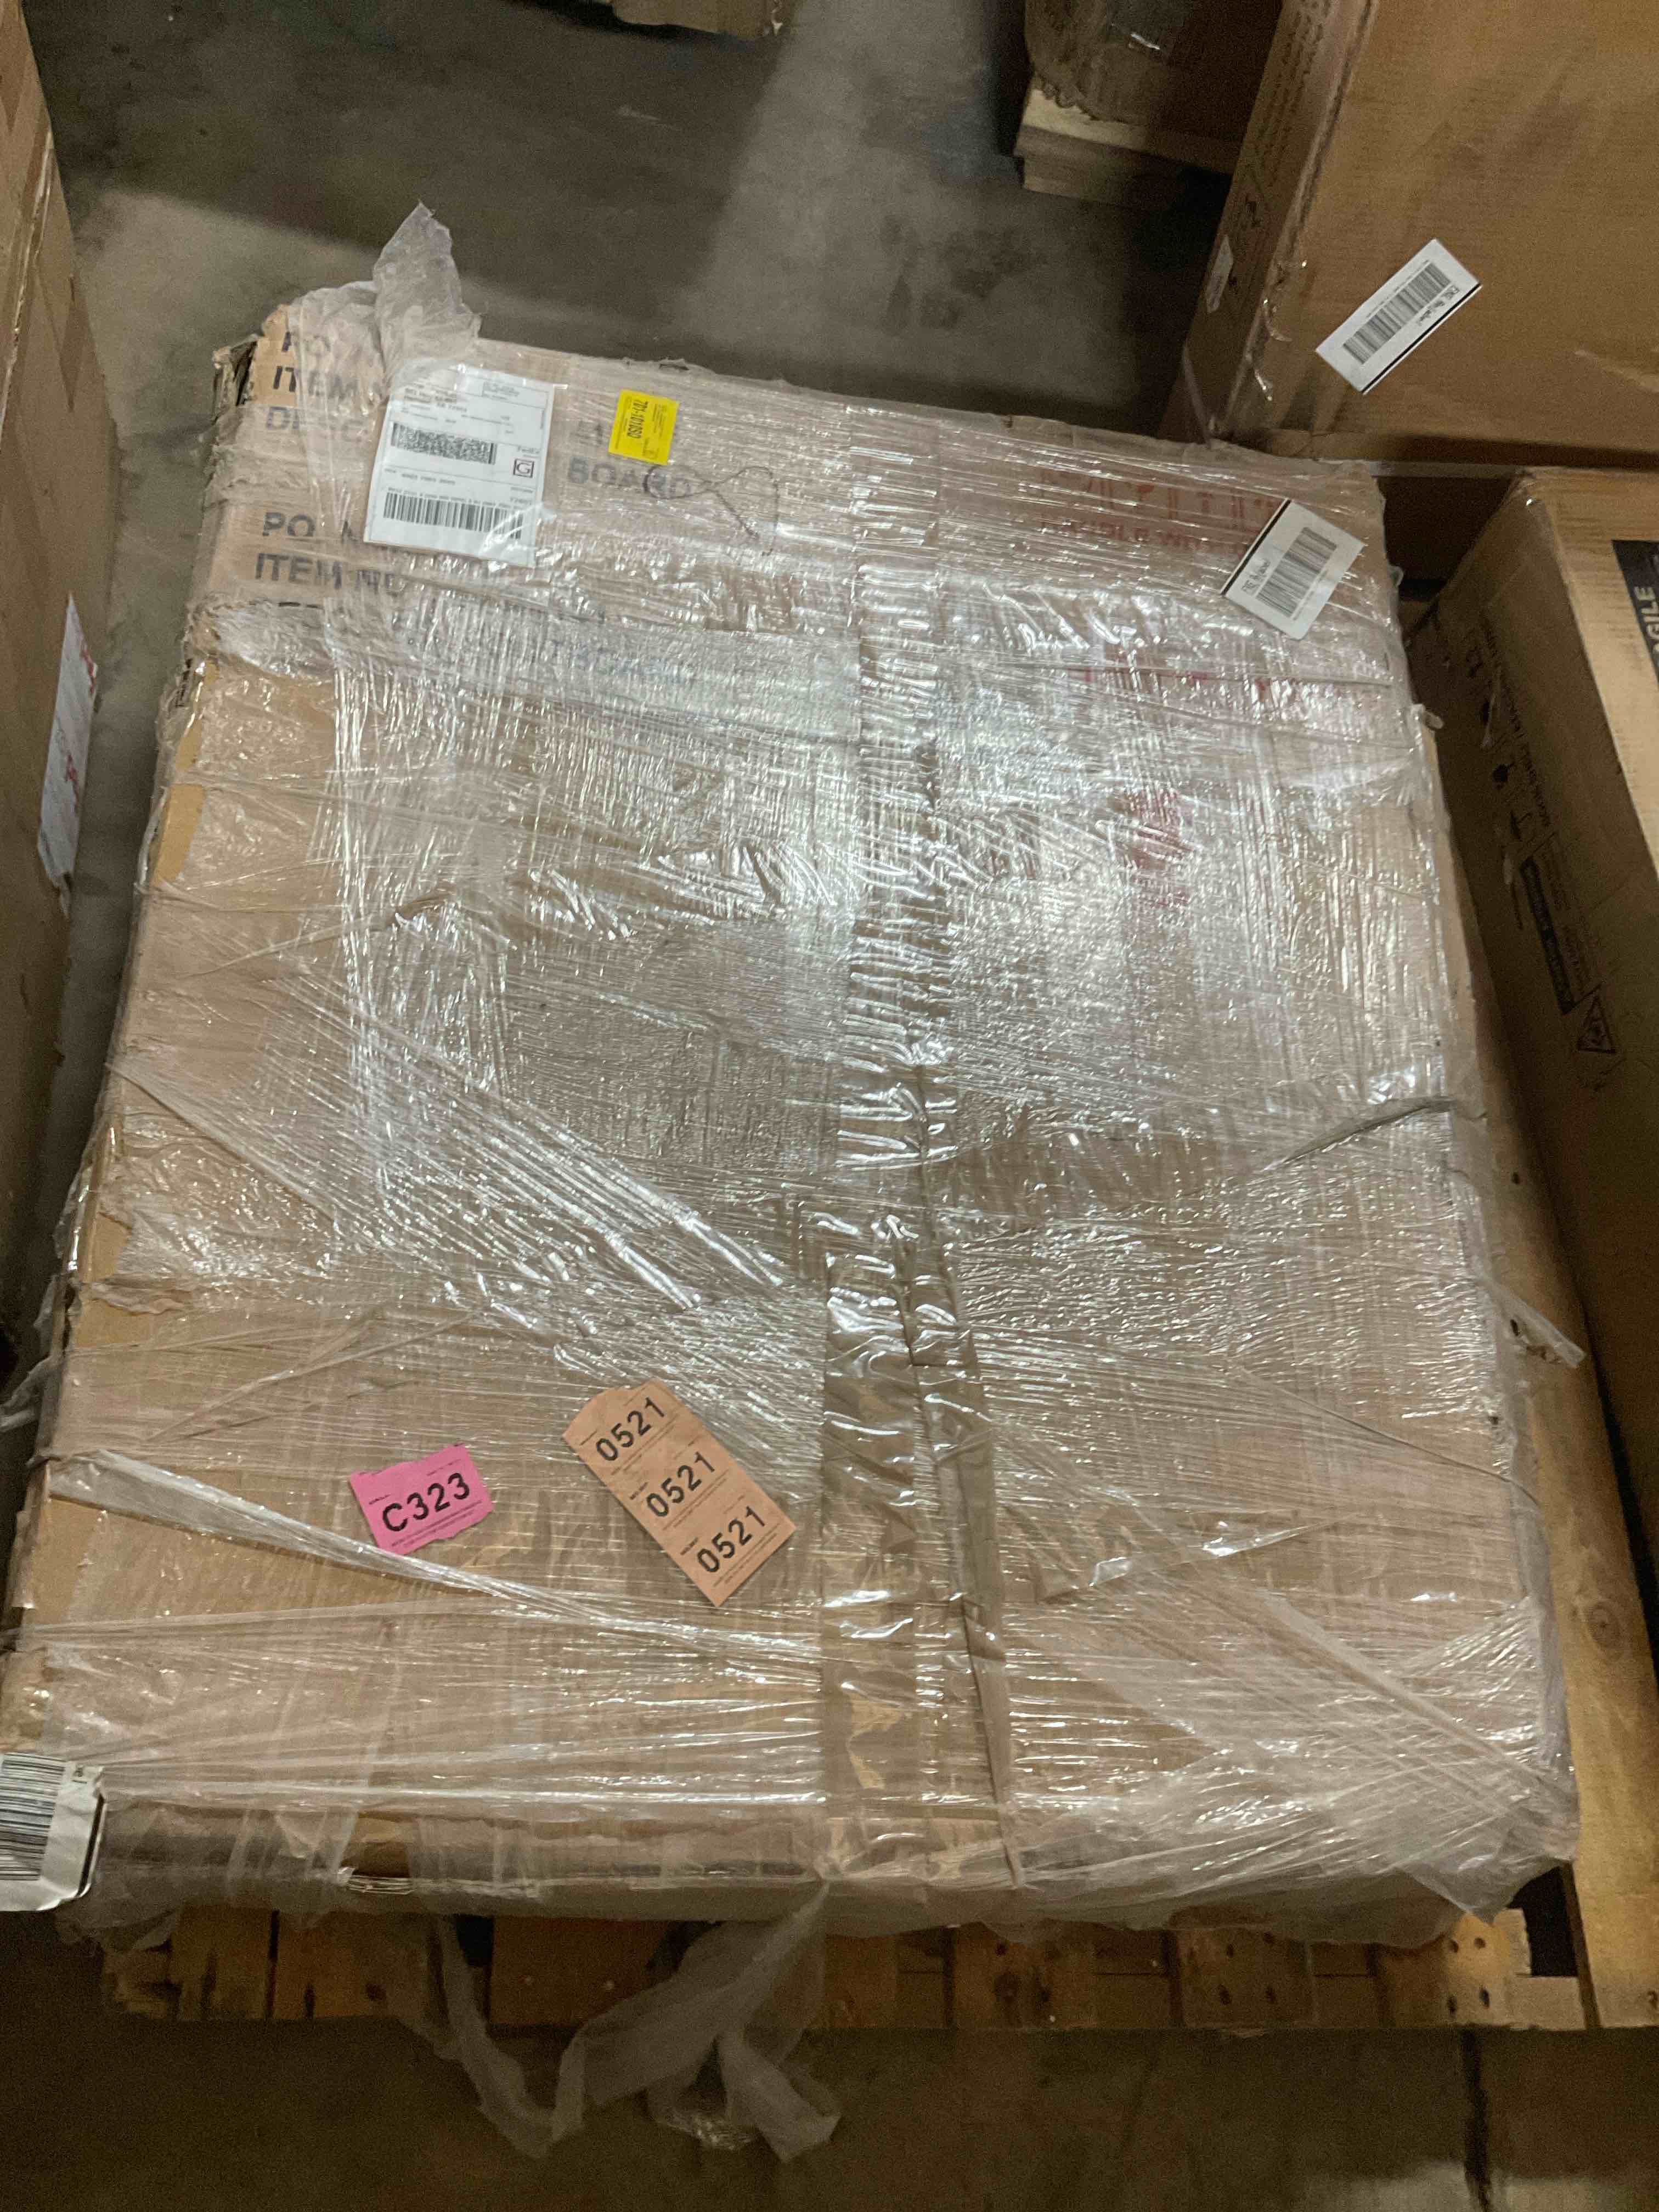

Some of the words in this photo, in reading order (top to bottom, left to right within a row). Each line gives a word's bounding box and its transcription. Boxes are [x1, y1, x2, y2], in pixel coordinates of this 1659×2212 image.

[515, 462, 531, 475] G
[255, 552, 343, 589] ITEM
[596, 1396, 665, 1462] 0521
[382, 1472, 471, 1533] C323
[647, 1451, 715, 1518] 0521
[697, 1505, 767, 1573] 0521
